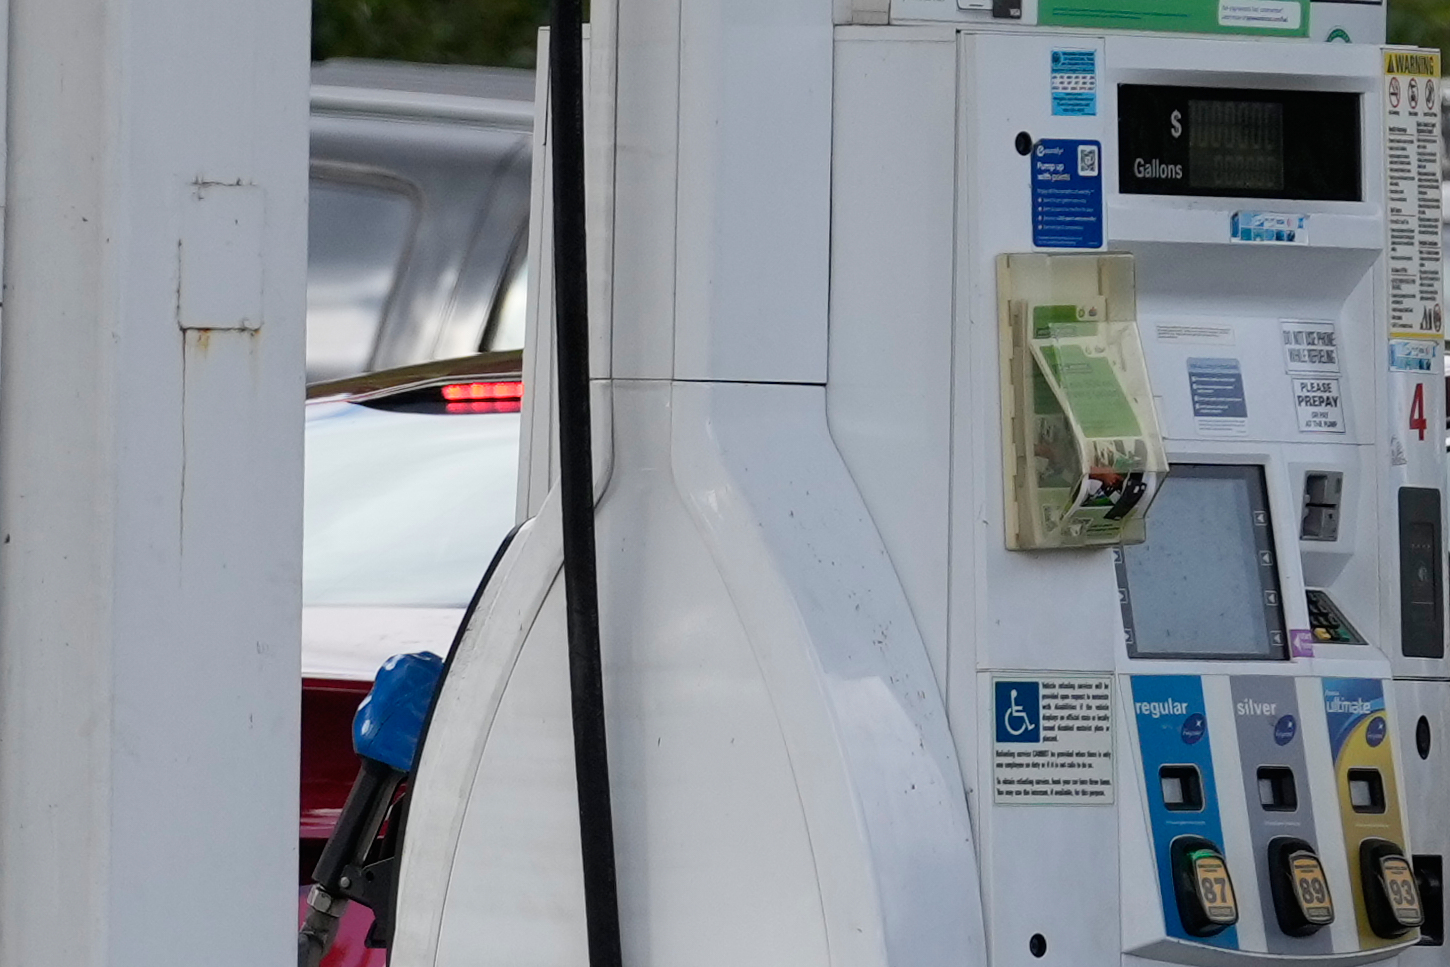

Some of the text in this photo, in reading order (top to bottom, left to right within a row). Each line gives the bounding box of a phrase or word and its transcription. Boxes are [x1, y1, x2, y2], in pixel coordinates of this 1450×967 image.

[1395, 54, 1434, 75] WARNING
[1170, 109, 1183, 139] $
[1133, 158, 1183, 180] Gallons
[1283, 330, 1292, 345] DO
[1293, 330, 1304, 346] NOT
[1300, 382, 1333, 393] PLEASE
[1297, 395, 1339, 408] PREPAY
[1409, 383, 1427, 441] 4
[1135, 697, 1188, 719] regular
[1236, 698, 1277, 716] silver
[1326, 697, 1371, 714] ultimate
[1201, 877, 1228, 904] 87
[1299, 877, 1326, 905] 89
[1389, 879, 1416, 906] 93
